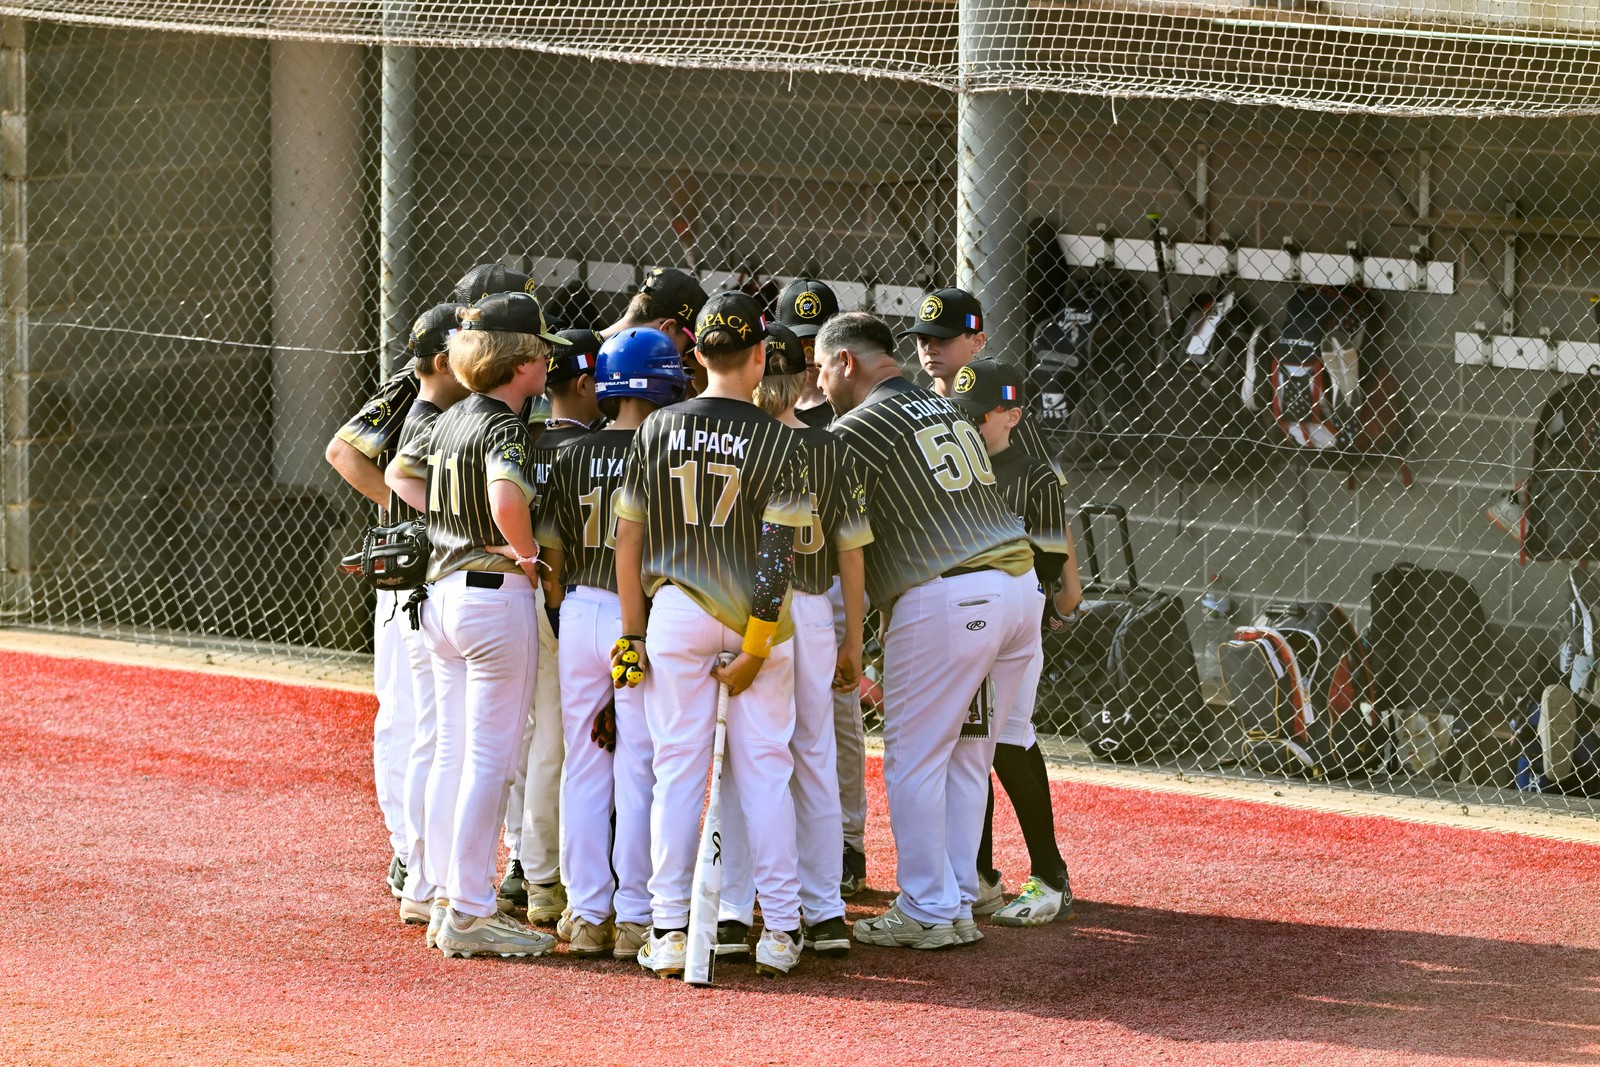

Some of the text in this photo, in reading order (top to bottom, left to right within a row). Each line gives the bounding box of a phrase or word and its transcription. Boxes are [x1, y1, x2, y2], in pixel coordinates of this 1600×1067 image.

[678, 303, 694, 321] 21
[769, 341, 786, 350] TIM
[901, 397, 957, 421] COACH
[667, 429, 749, 460] M.PACK
[913, 420, 997, 492] 50
[590, 458, 625, 478] ILYA
[427, 448, 461, 516] 11
[669, 459, 740, 528] 17
